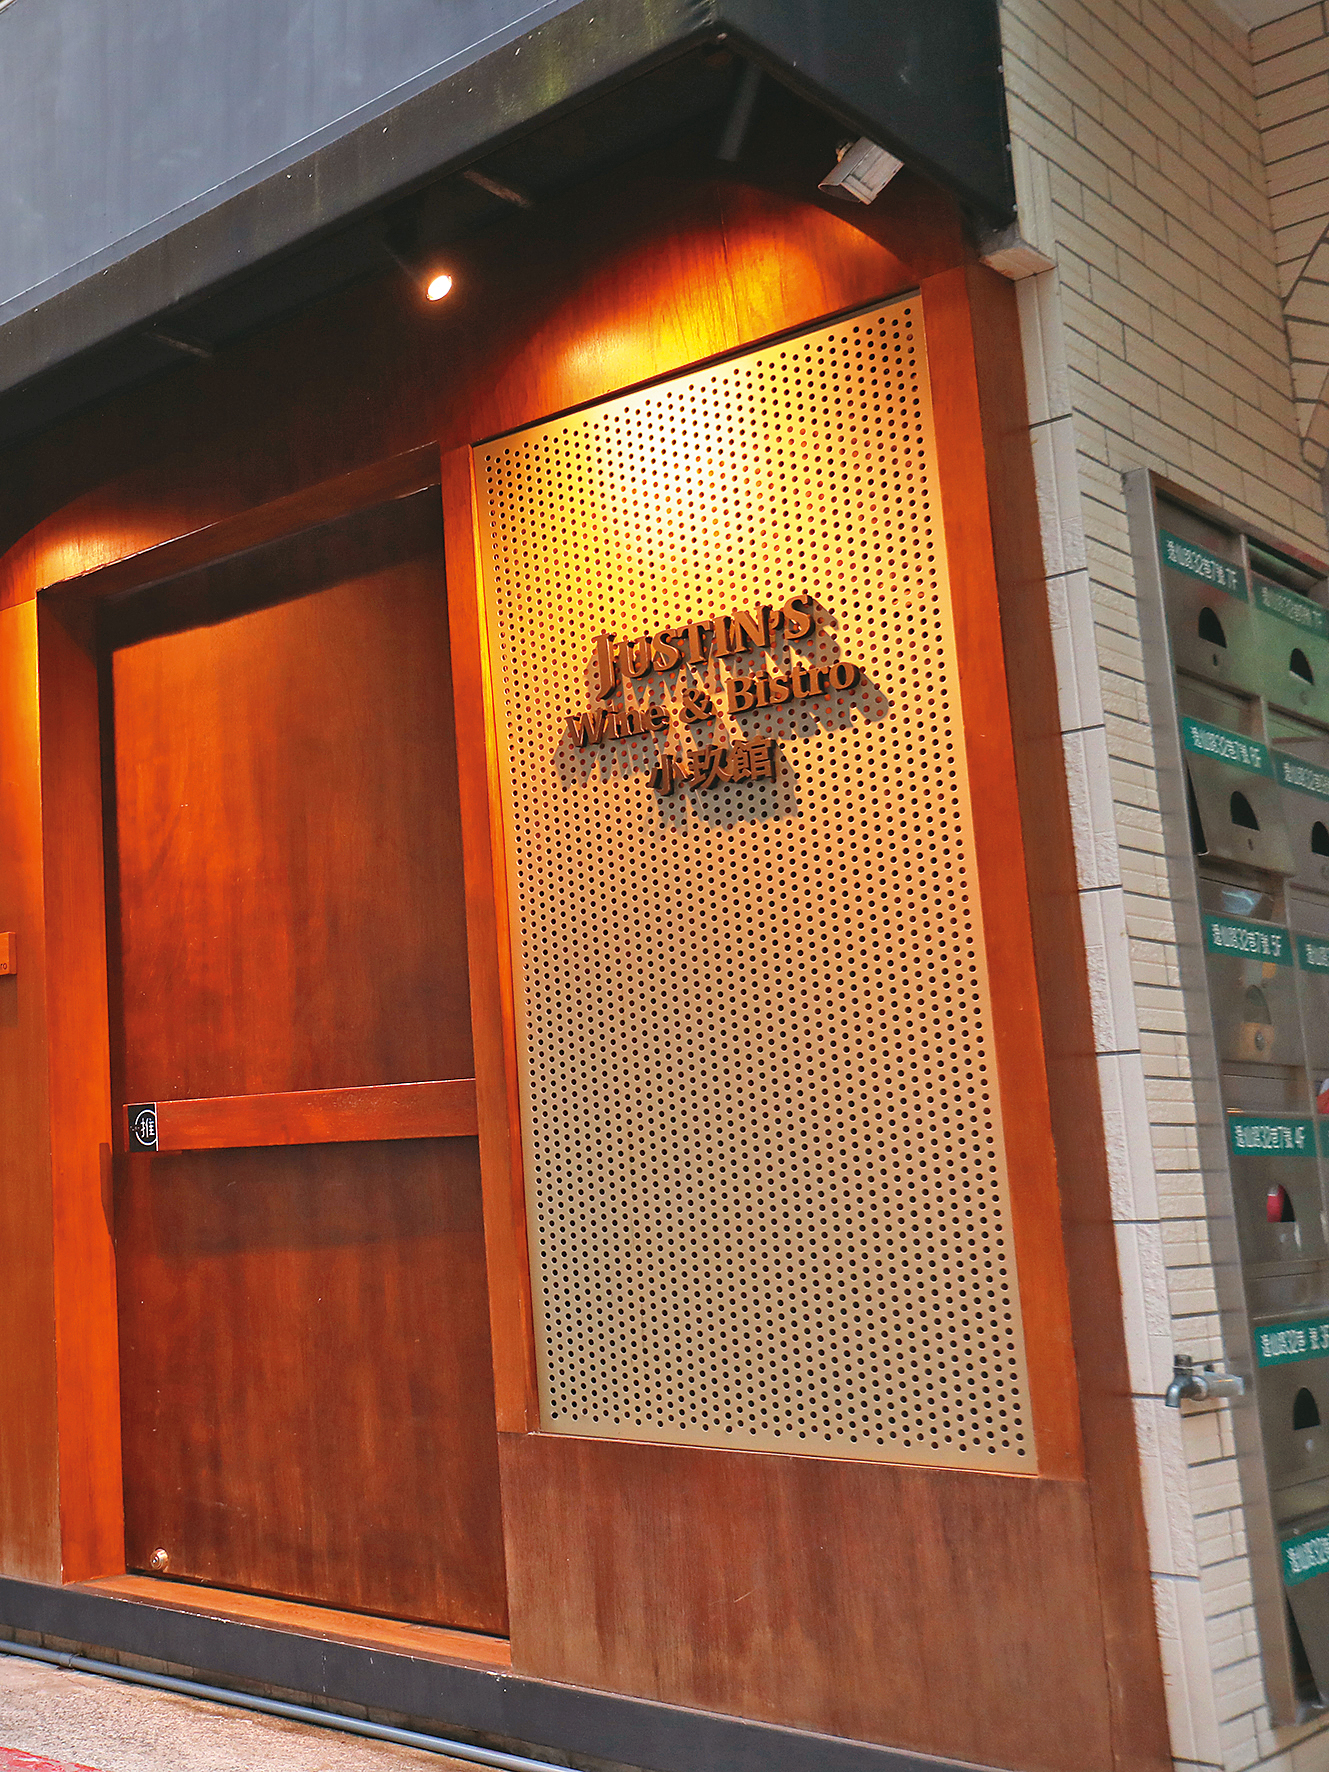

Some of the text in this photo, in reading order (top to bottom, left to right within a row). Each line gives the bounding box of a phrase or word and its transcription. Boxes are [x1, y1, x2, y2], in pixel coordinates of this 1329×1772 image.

[592, 593, 819, 700] JUSTIN'S
[565, 661, 863, 748] Wine & Bistro
[648, 734, 779, 797] 小玖館
